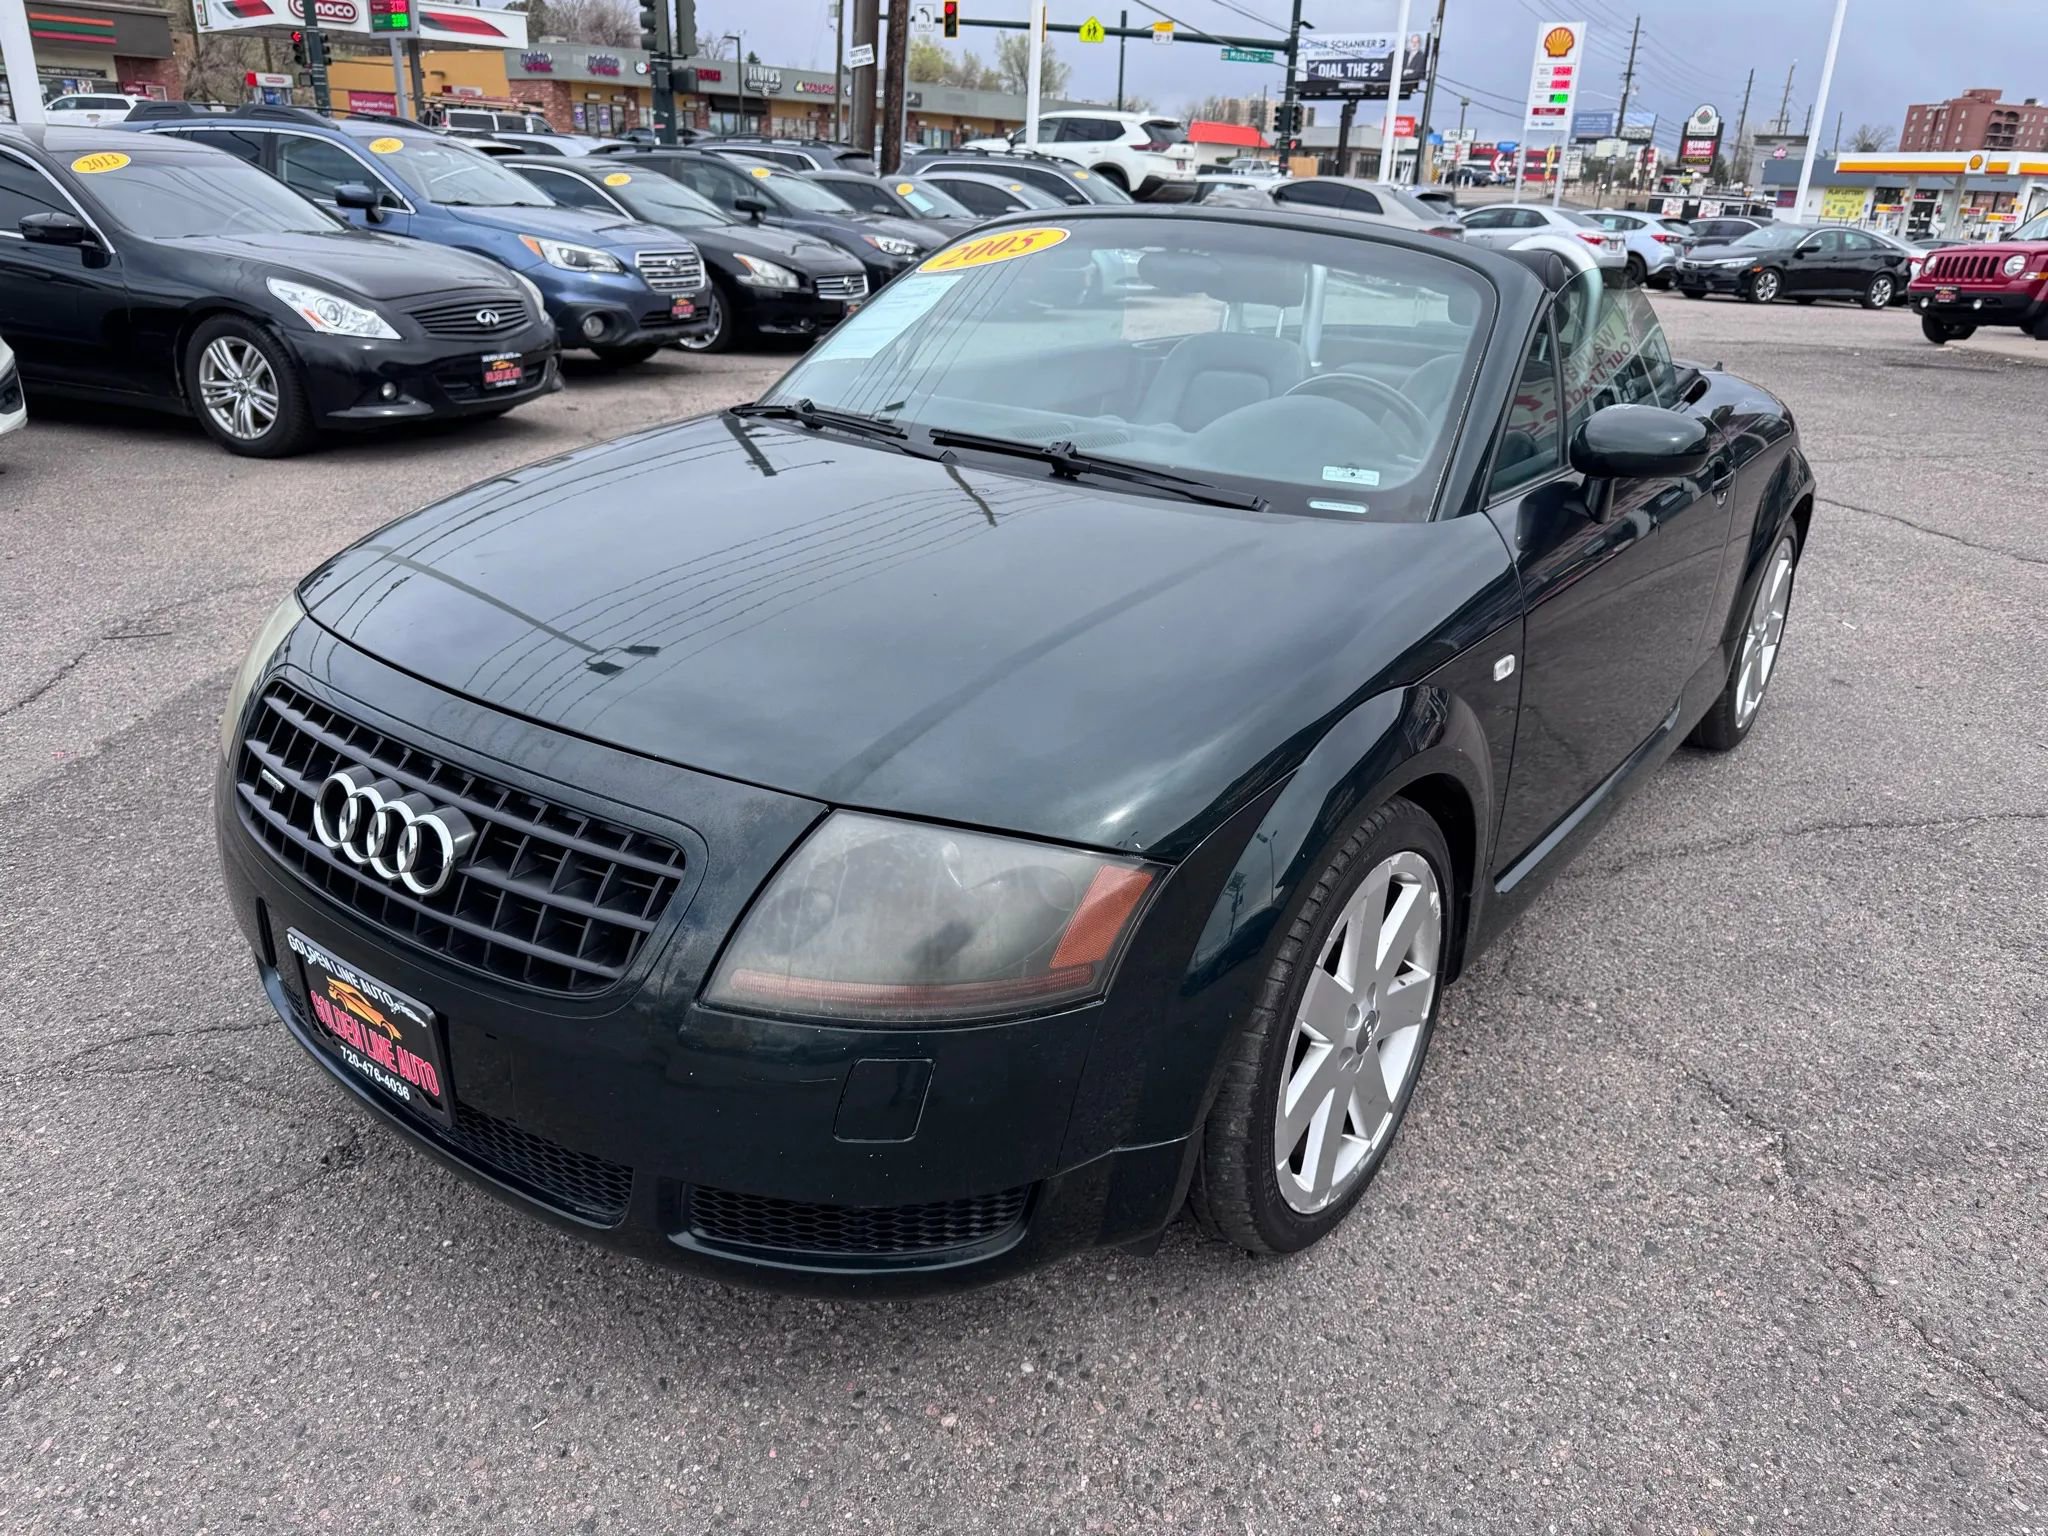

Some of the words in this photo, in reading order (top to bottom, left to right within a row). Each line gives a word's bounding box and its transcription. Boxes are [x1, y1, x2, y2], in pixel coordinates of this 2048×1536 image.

[1331, 39, 1377, 49] SCHANKER
[1318, 62, 1344, 78] DIAL
[1346, 63, 1369, 77] THE
[82, 153, 120, 171] 2013
[940, 231, 1043, 266] 2005
[287, 933, 334, 974] GOLDEN
[331, 961, 361, 990] LINE
[360, 978, 394, 1006] AUTO
[310, 990, 365, 1053] GOLDEN
[360, 1024, 398, 1074] LINE
[397, 1045, 440, 1096] AUTO
[340, 1045, 411, 1101] 720-476-4036
